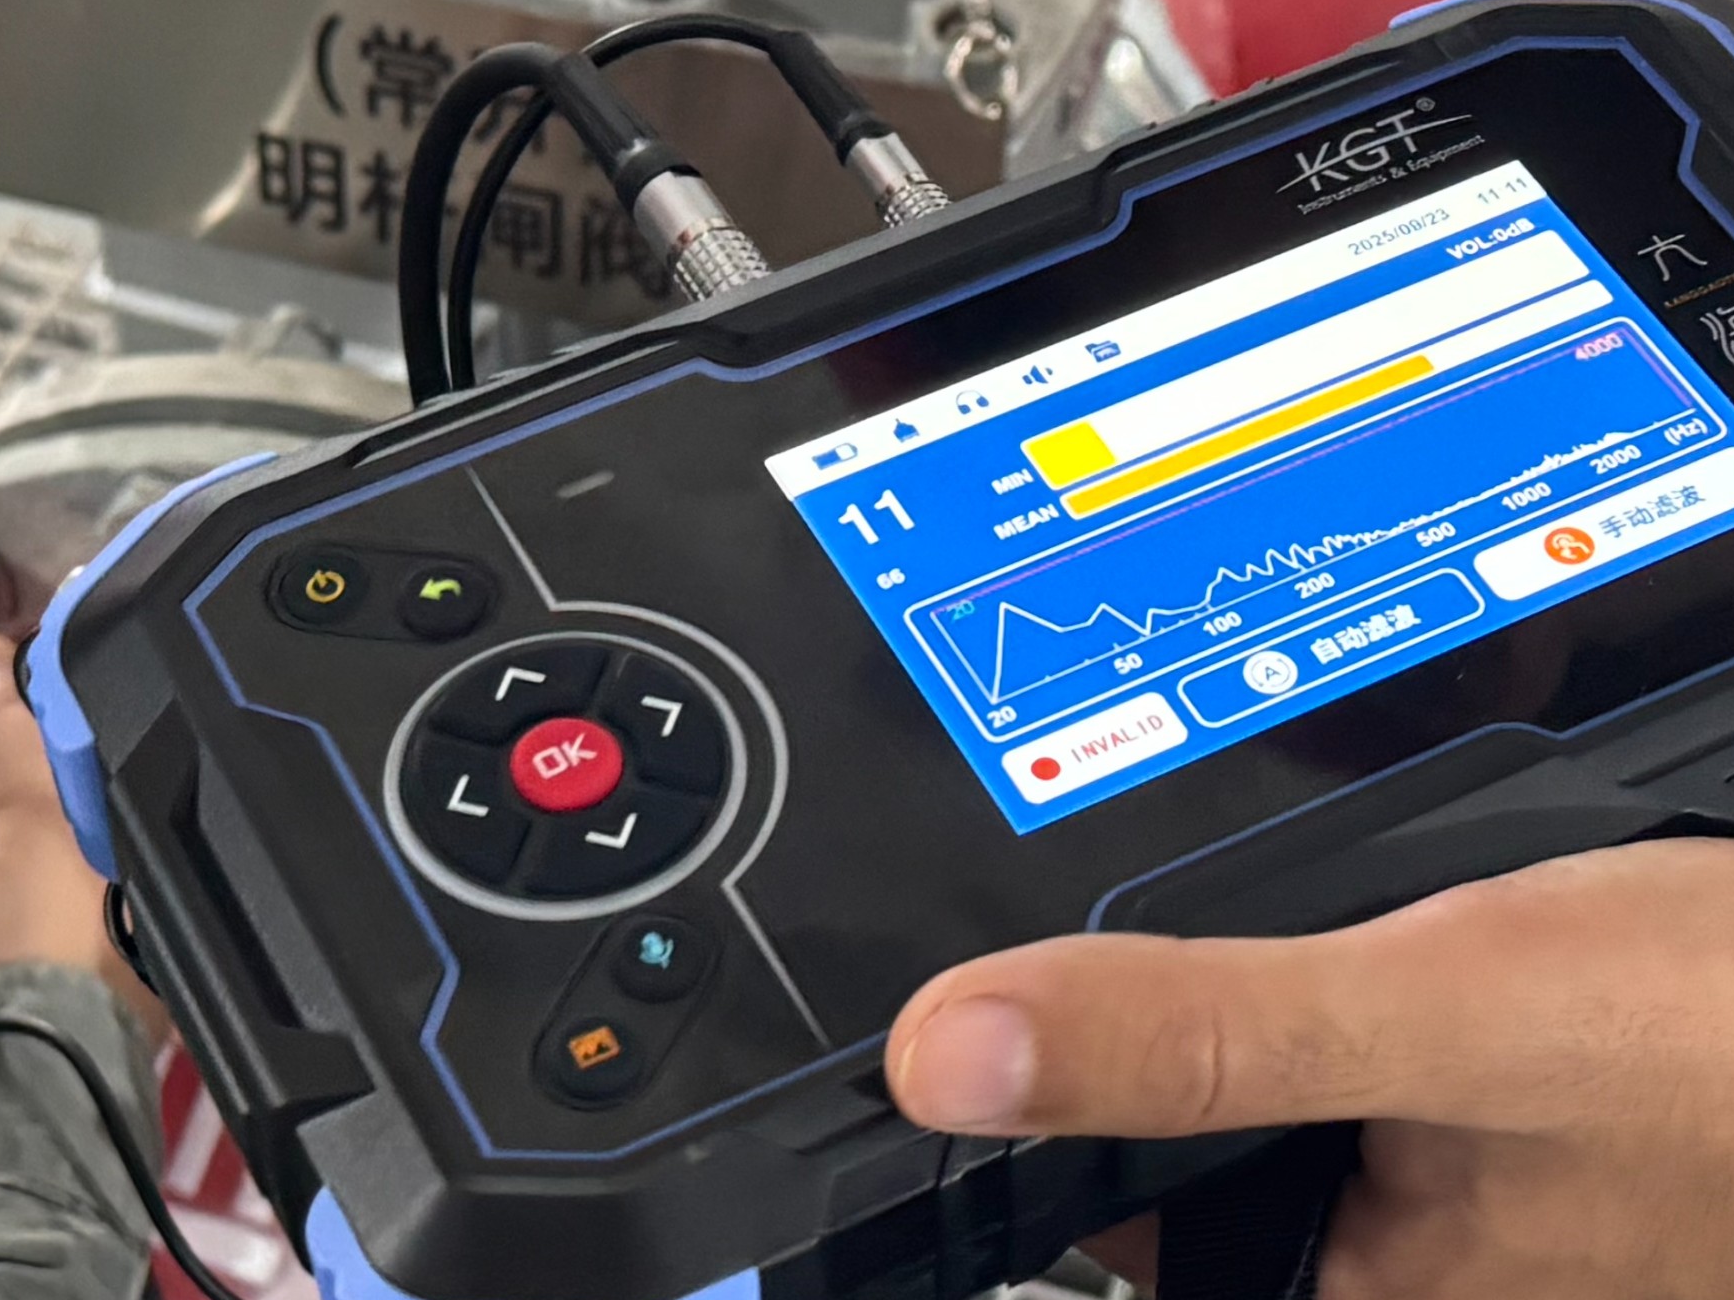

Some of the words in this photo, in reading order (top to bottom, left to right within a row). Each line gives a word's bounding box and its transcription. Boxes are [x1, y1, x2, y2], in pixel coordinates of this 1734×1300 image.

[1297, 173, 1388, 215] Instruments
[1389, 166, 1408, 180] &
[1406, 134, 1486, 173] Equipment
[1574, 333, 1624, 362] 4000
[991, 468, 1035, 496] MIN
[837, 488, 916, 545] 11
[993, 503, 1060, 540] MEAN
[1598, 484, 1707, 539] 手动滤波
[986, 706, 1018, 729] 20
[1113, 652, 1144, 675] 50
[1202, 611, 1243, 638] 100
[1294, 572, 1335, 599] 200
[1415, 521, 1457, 548] 500
[1501, 481, 1552, 511] 1000
[1589, 444, 1642, 475] 2000
[1663, 418, 1709, 445] (Hz)
[1309, 603, 1422, 665] 自动滤波
[531, 734, 597, 780] OK
[1070, 713, 1165, 764] INVALID
